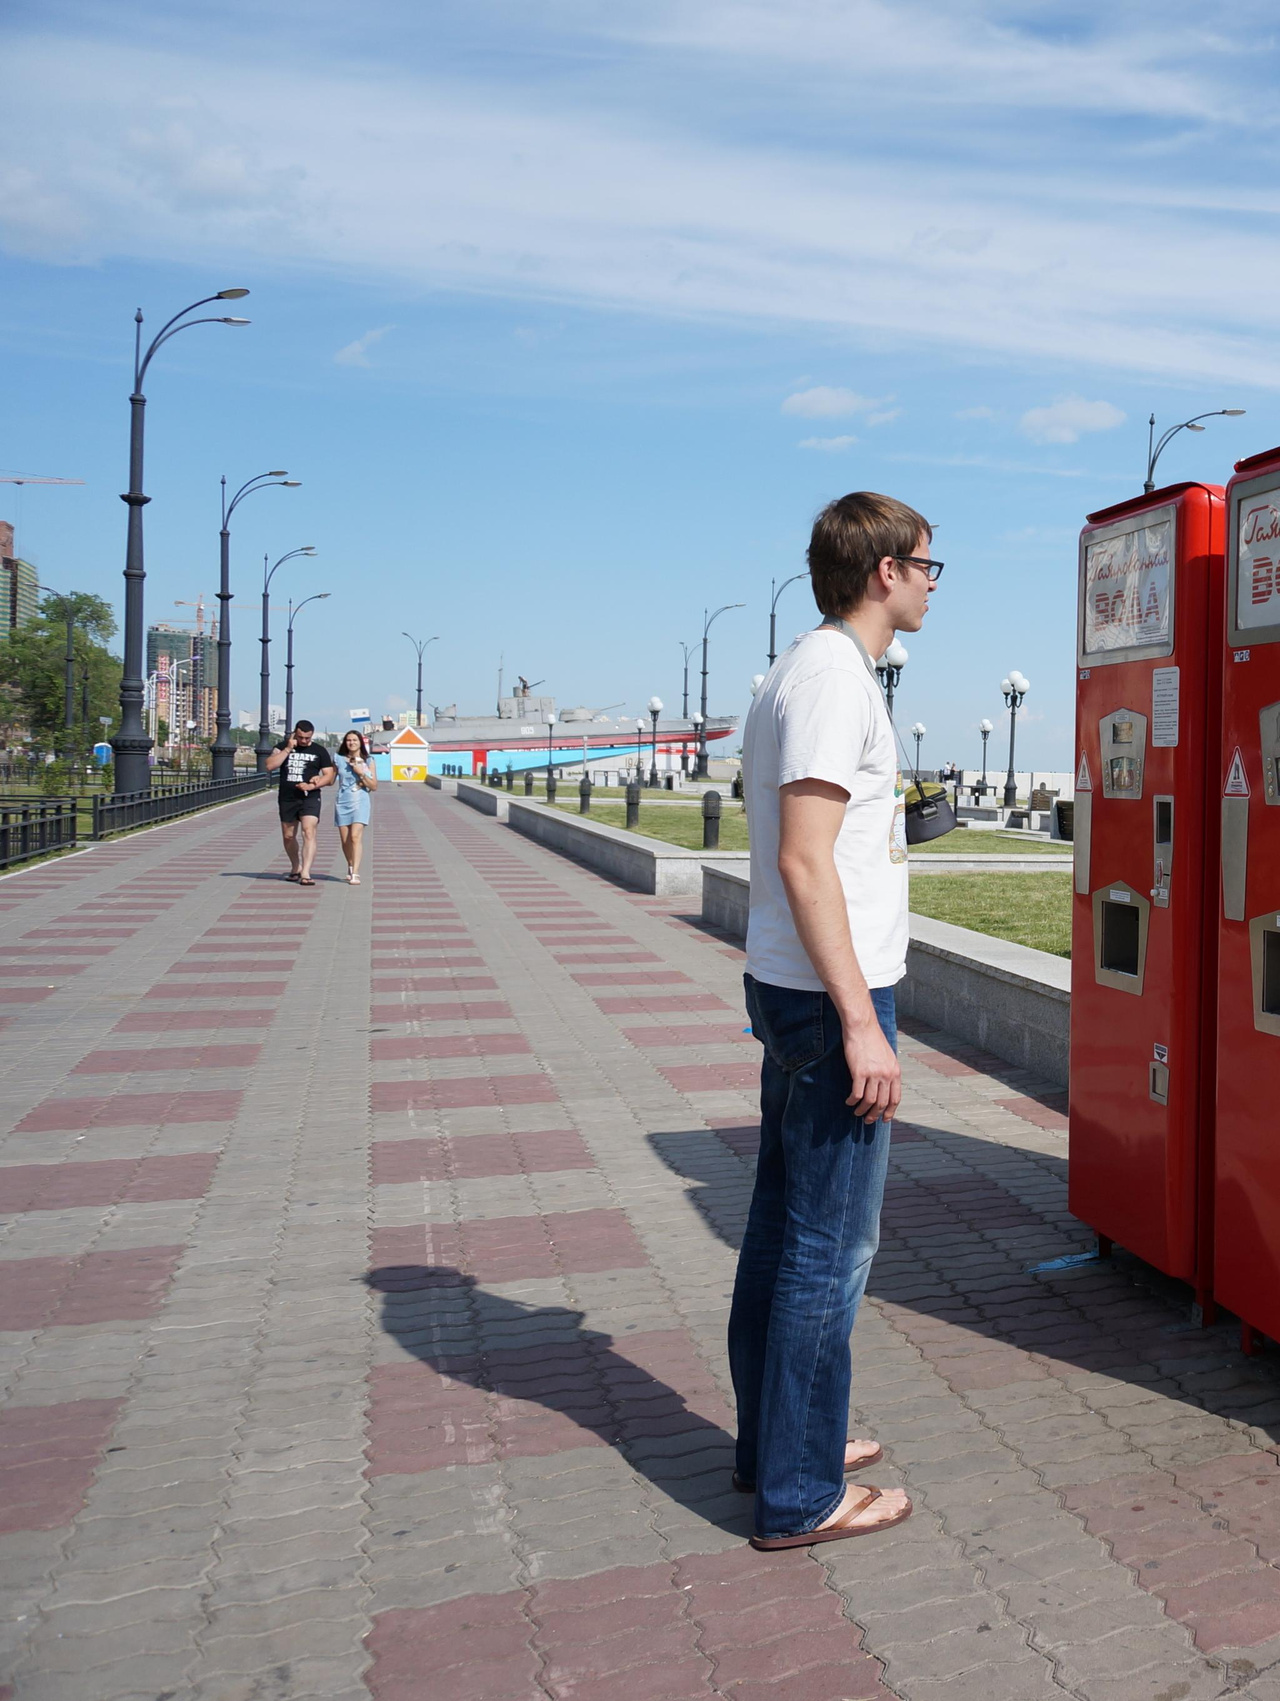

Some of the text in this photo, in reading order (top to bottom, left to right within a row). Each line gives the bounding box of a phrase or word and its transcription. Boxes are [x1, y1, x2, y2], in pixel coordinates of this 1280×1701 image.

[1094, 581, 1160, 632] ВОДА
[288, 753, 317, 761] CRAZY
[286, 760, 306, 768] FOR
